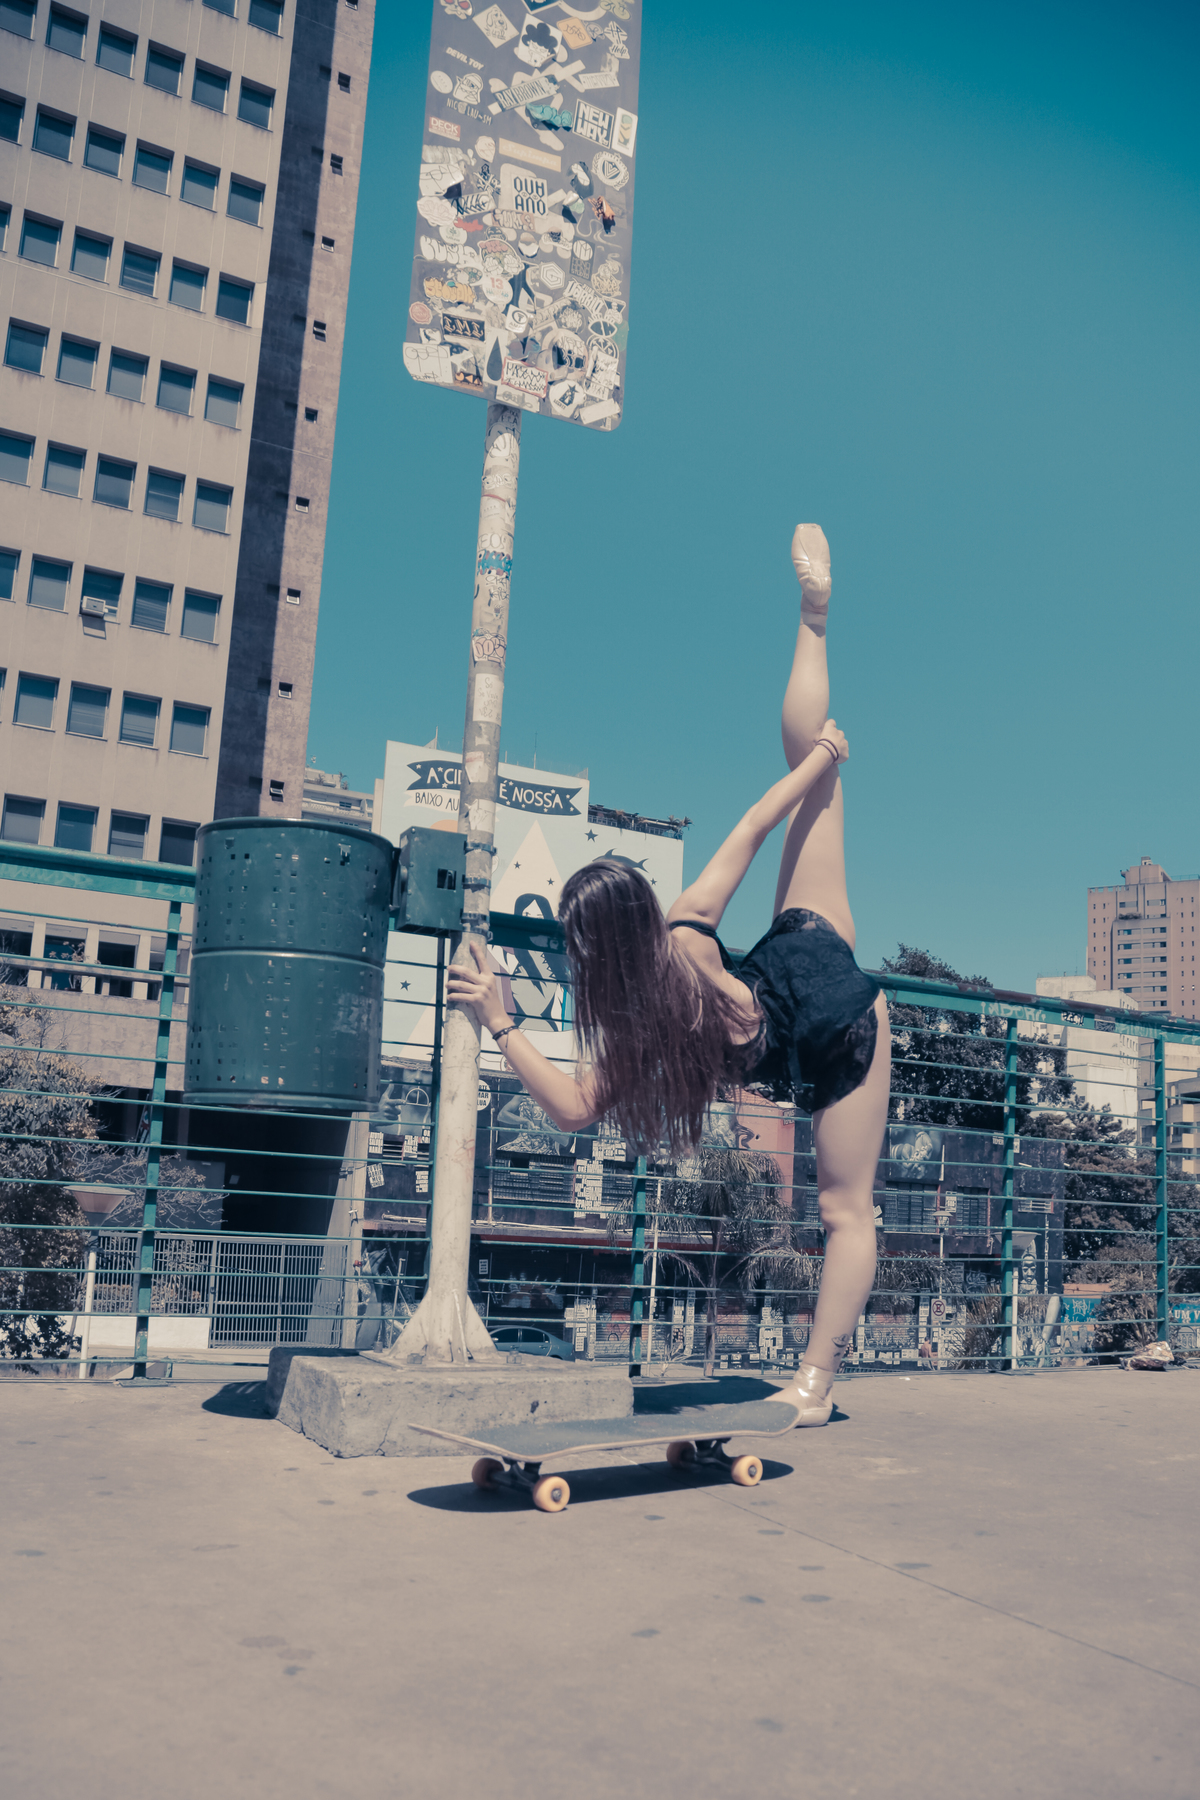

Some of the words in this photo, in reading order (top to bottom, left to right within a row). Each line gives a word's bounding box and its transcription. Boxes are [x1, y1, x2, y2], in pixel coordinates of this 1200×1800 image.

[446, 47, 468, 64] DEVIL
[468, 58, 484, 70] TOY
[512, 79, 547, 102] BROWN
[431, 117, 459, 134] DECK
[578, 102, 609, 130] NEW
[576, 118, 608, 144] WAY
[489, 277, 504, 290] 13
[415, 792, 443, 807] BAIXO
[427, 767, 440, 784] A
[499, 780, 508, 800] É
[512, 786, 563, 809] NOSSA
[1174, 1309, 1190, 1320] UM
